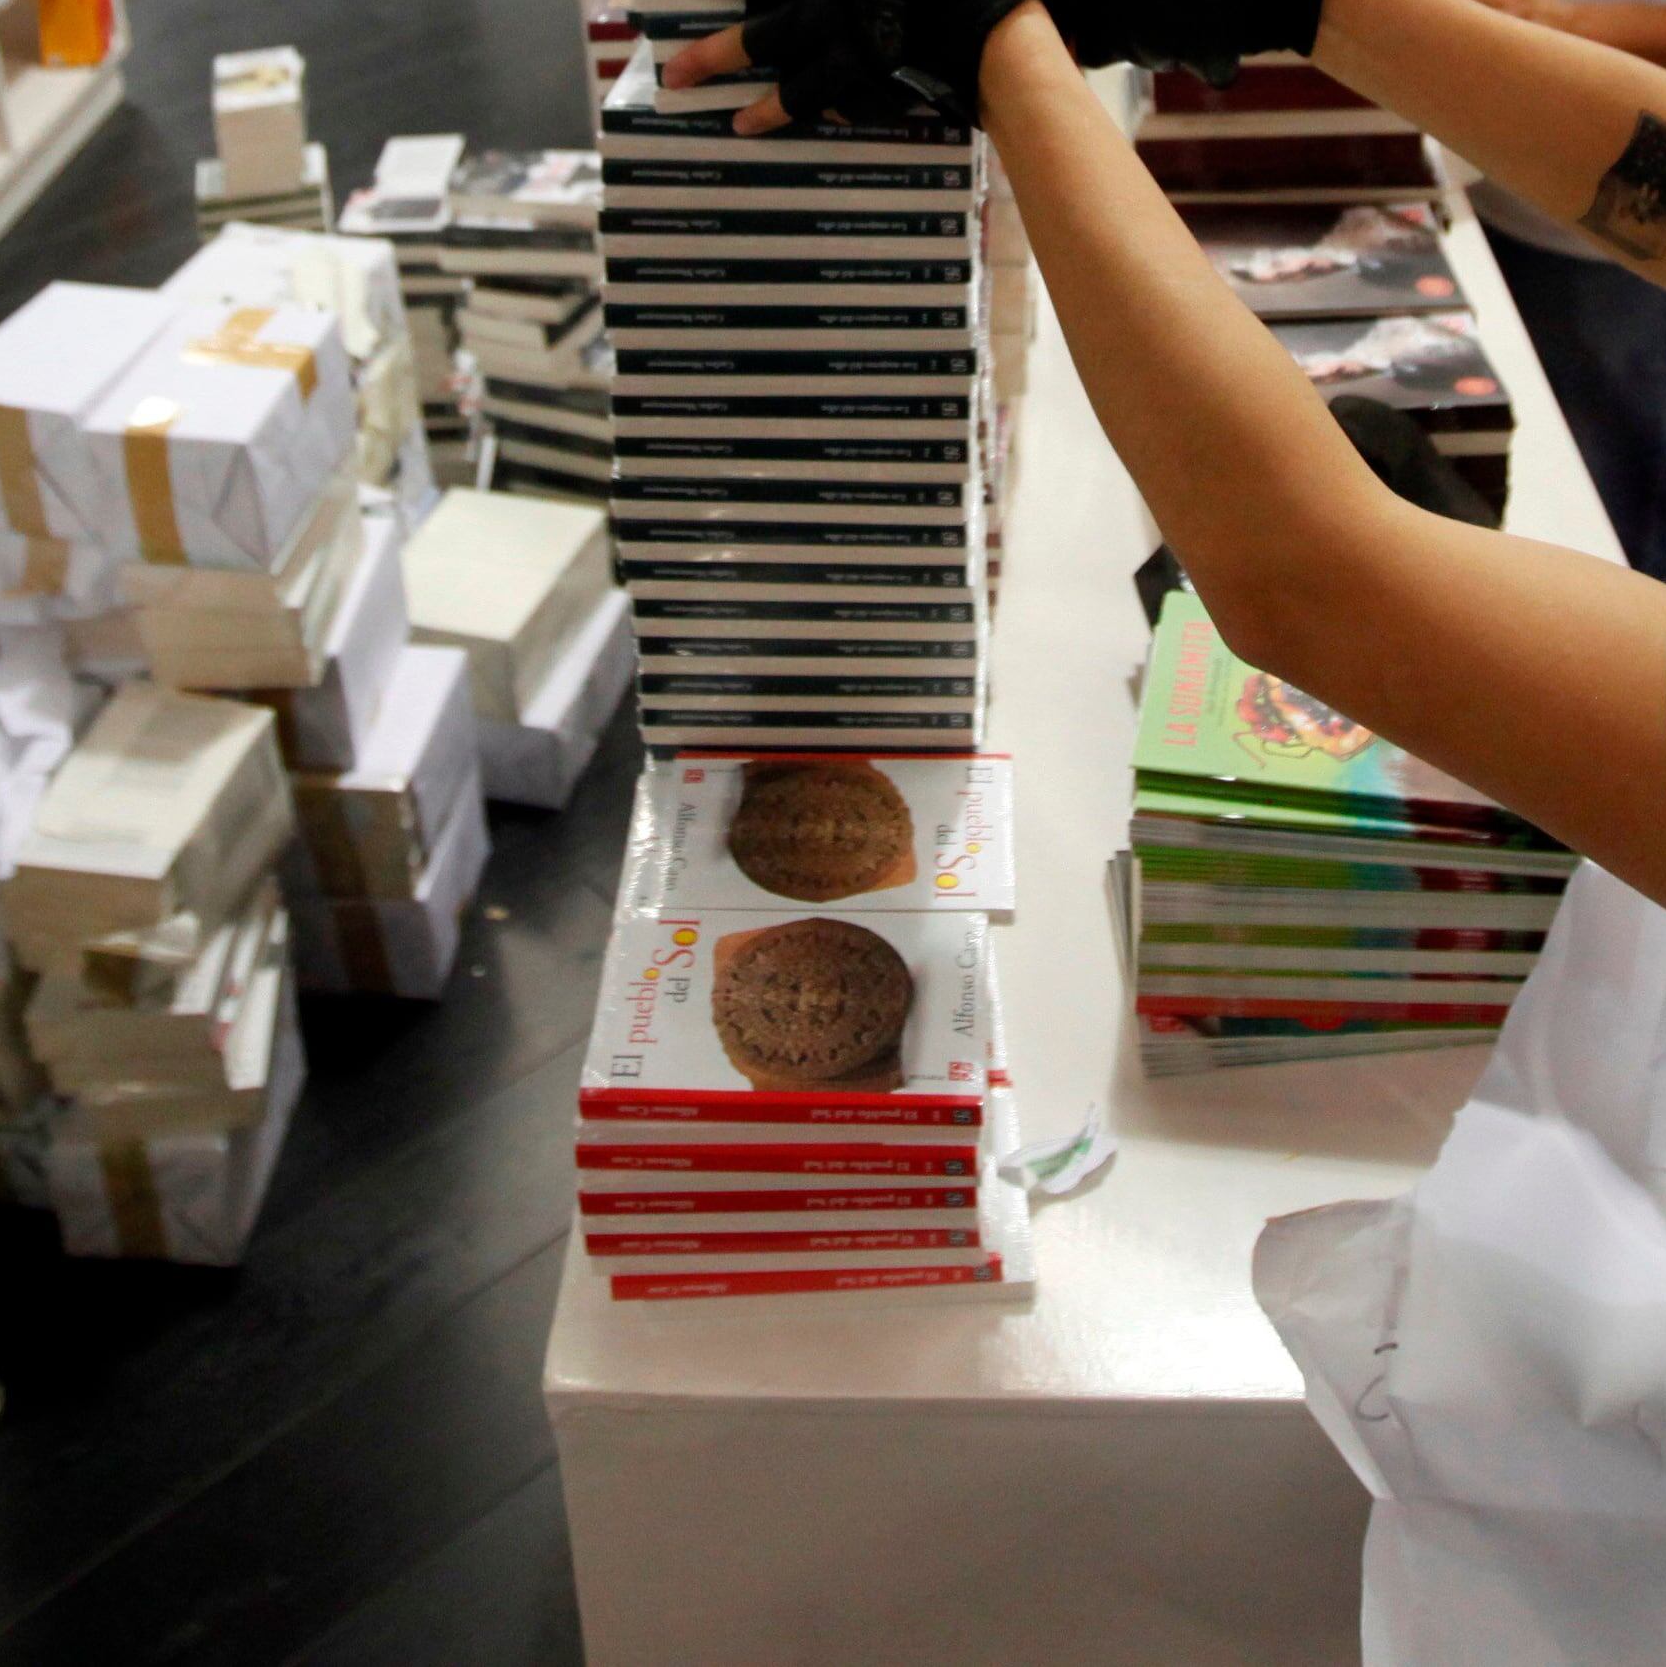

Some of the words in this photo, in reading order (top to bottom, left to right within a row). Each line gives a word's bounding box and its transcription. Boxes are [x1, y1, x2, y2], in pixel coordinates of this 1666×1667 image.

[1168, 620, 1214, 718] SUNAMITA
[1163, 722, 1197, 746] LA
[935, 824, 958, 845] del
[956, 791, 993, 854] pueblo
[934, 852, 977, 897] Sol
[652, 918, 701, 969] Sol
[625, 966, 661, 1044] pueblo
[664, 977, 691, 1003] del
[951, 974, 975, 1037] Alfonso
[610, 1054, 644, 1078] El
